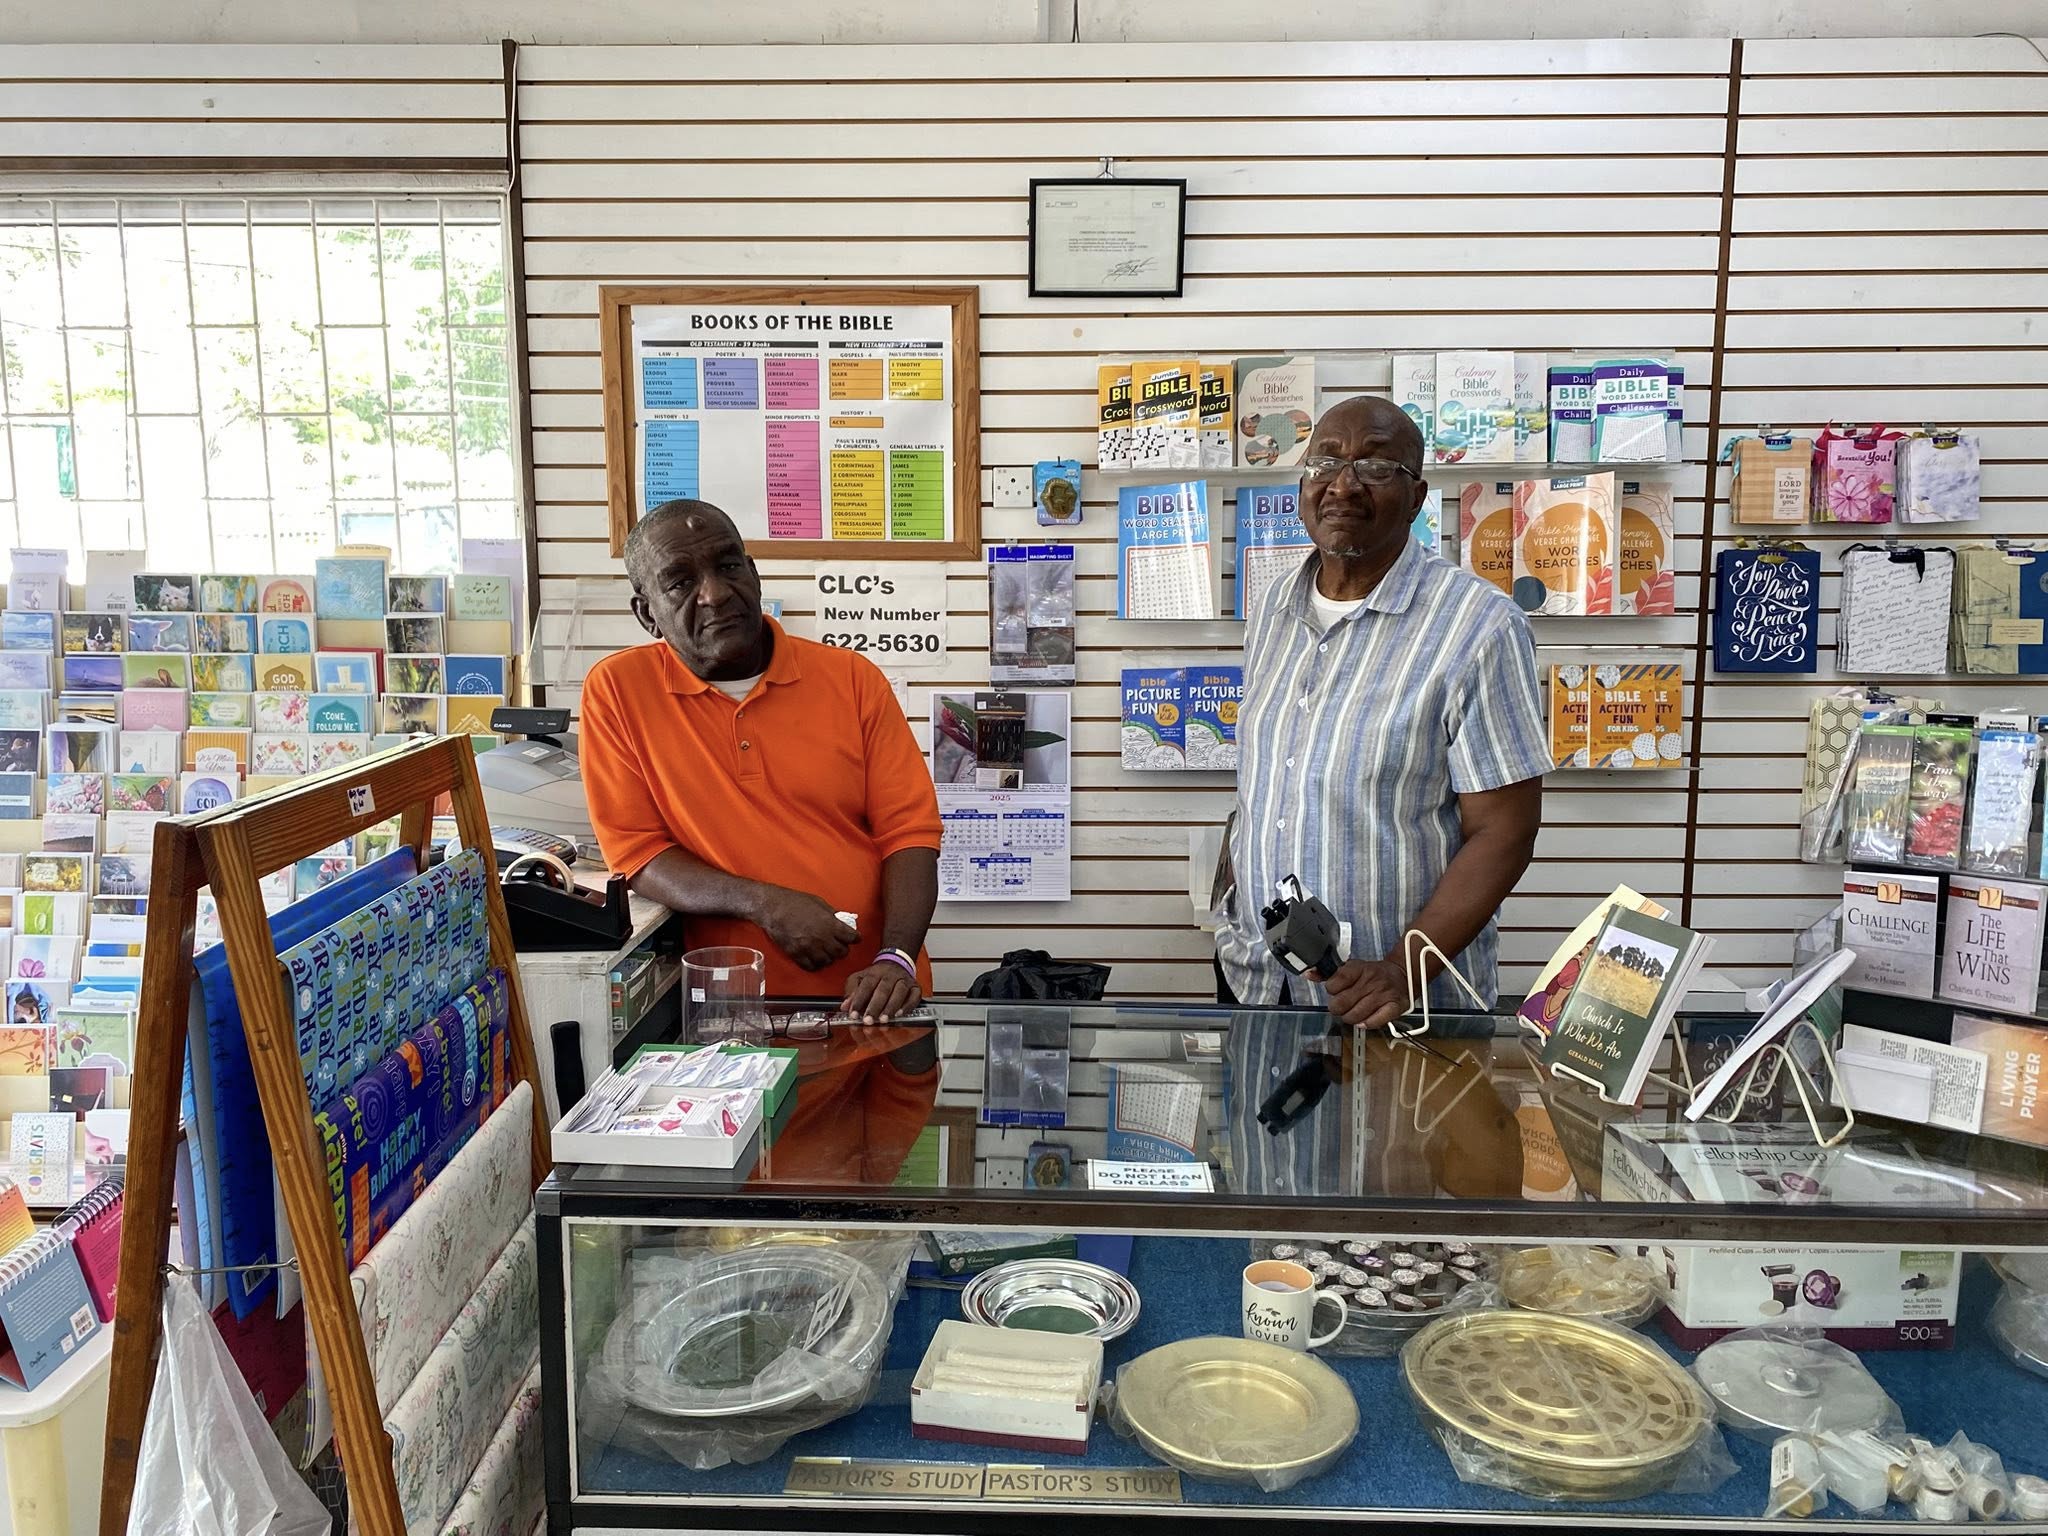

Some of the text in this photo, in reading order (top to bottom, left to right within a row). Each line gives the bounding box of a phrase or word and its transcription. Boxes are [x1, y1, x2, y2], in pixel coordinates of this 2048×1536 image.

[691, 315, 894, 331] BOOKS OF THE BIBLE
[1151, 369, 1180, 381] Jumbo
[1454, 365, 1497, 381] Calming
[1619, 367, 1644, 378] Daily
[1144, 378, 1188, 399] BIBLE
[1263, 383, 1289, 394] Bible
[1462, 378, 1489, 390] Bible
[1604, 379, 1660, 394] BIBLE
[1250, 394, 1304, 404] Word Searches
[1450, 387, 1501, 398] Crosswords
[1601, 392, 1664, 402] WORD SEARCH
[1136, 395, 1194, 416] Crossword
[1609, 404, 1655, 414] Challenge
[1168, 412, 1189, 423] Fun
[1202, 415, 1221, 424] Fun
[1865, 450, 1893, 466] You!
[1553, 481, 1584, 490] LARGE PRINT
[1779, 480, 1802, 488] LORD
[1137, 492, 1196, 516] BIBLE
[1123, 518, 1158, 529] WORD
[1243, 518, 1277, 528] WORD
[1135, 529, 1169, 540] LARGE
[1252, 530, 1287, 540] LARGE
[1480, 540, 1503, 548] VERSE
[1533, 537, 1558, 546] VERSE
[1621, 539, 1654, 548] ALLENGE
[1548, 546, 1580, 557] WOR
[1729, 560, 1777, 596] Joy
[818, 575, 895, 595] CLC's
[824, 607, 940, 621] New Number
[1742, 602, 1804, 636] Peace
[821, 633, 940, 653] 622-5630
[1740, 623, 1807, 661] Grace
[272, 673, 296, 683] GOD
[1140, 677, 1167, 687] Bible
[1203, 675, 1230, 685] Bible
[1126, 688, 1181, 701] PICTURE
[1189, 686, 1244, 699] PICTURE
[1605, 690, 1641, 703] BIBLE
[1131, 702, 1159, 715] FUN
[1194, 700, 1222, 713] FUN
[1599, 704, 1647, 714] ACTIVITY
[1613, 715, 1633, 724] FUN
[315, 722, 343, 731] FOLLOW
[1923, 791, 1949, 801] way
[196, 798, 217, 809] GOD
[1980, 913, 2002, 930] The
[1982, 948, 2009, 965] That
[1949, 983, 1974, 995] Charles
[1581, 1005, 1626, 1035] Church Is
[1564, 1021, 1622, 1059] Who We Are
[1999, 1051, 2020, 1107] LIVING
[2020, 1053, 2041, 1119] PRAYER
[1694, 1147, 1828, 1164] Fellowship Cup
[1612, 1149, 1658, 1201] Fellowship
[1245, 1302, 1298, 1331] known
[1249, 1327, 1289, 1343] LOVED
[1899, 1326, 1931, 1341] 500
[790, 1466, 979, 1491] PASTOR'S STUDY
[988, 1473, 1175, 1494] PASTOR'S STUDY
